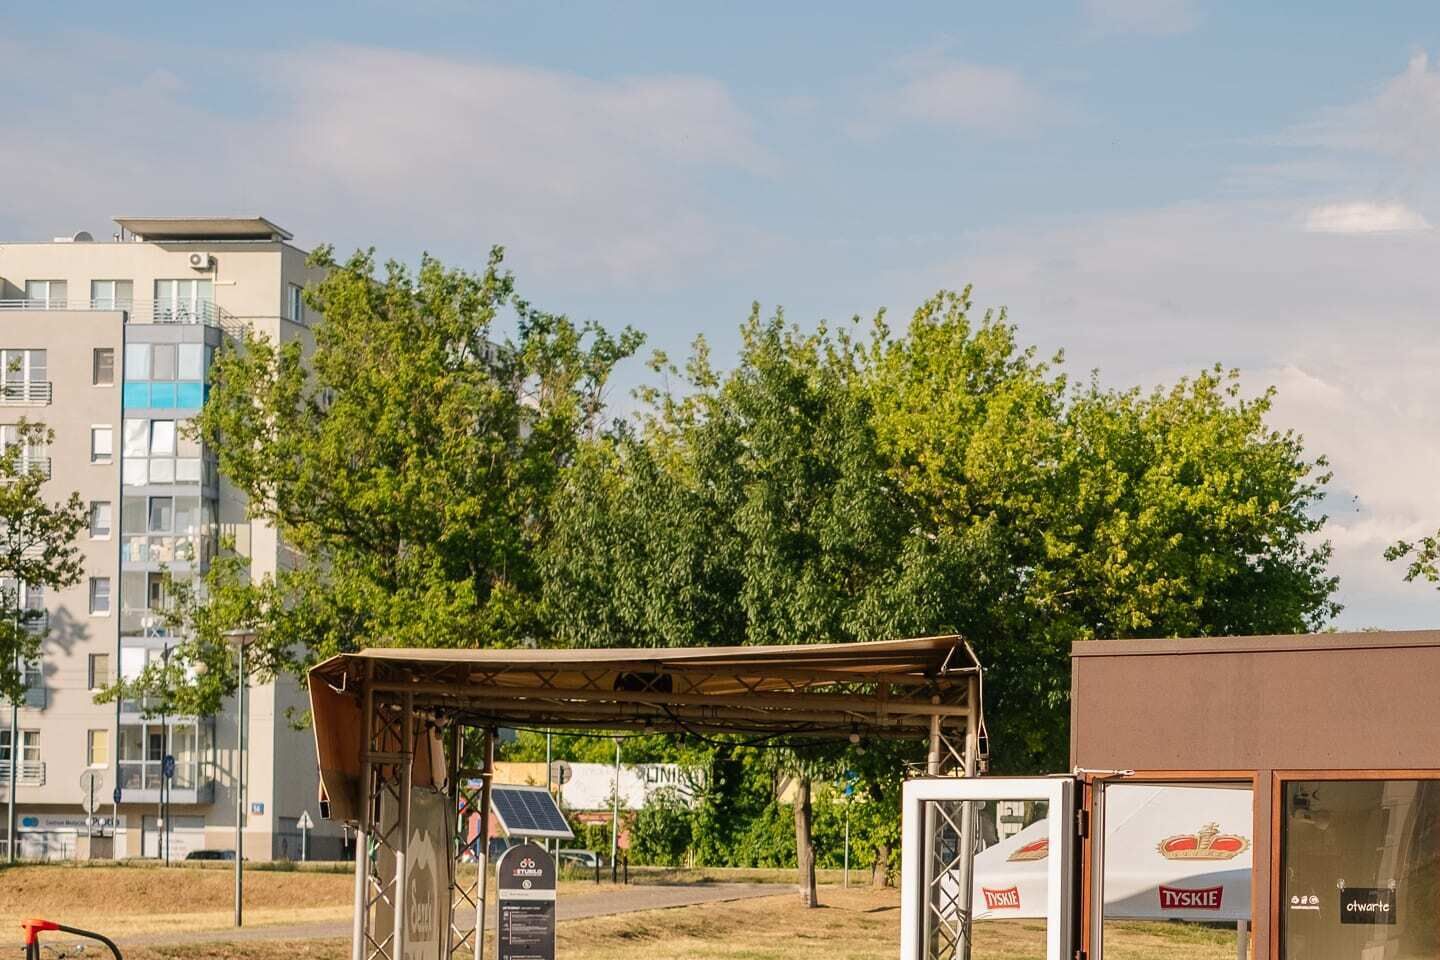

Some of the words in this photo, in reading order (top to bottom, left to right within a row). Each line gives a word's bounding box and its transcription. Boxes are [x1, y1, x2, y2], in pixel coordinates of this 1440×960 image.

[986, 890, 1017, 907] TYSKIE
[1161, 889, 1218, 907] TYSKIE
[1346, 899, 1390, 913] otwarte
